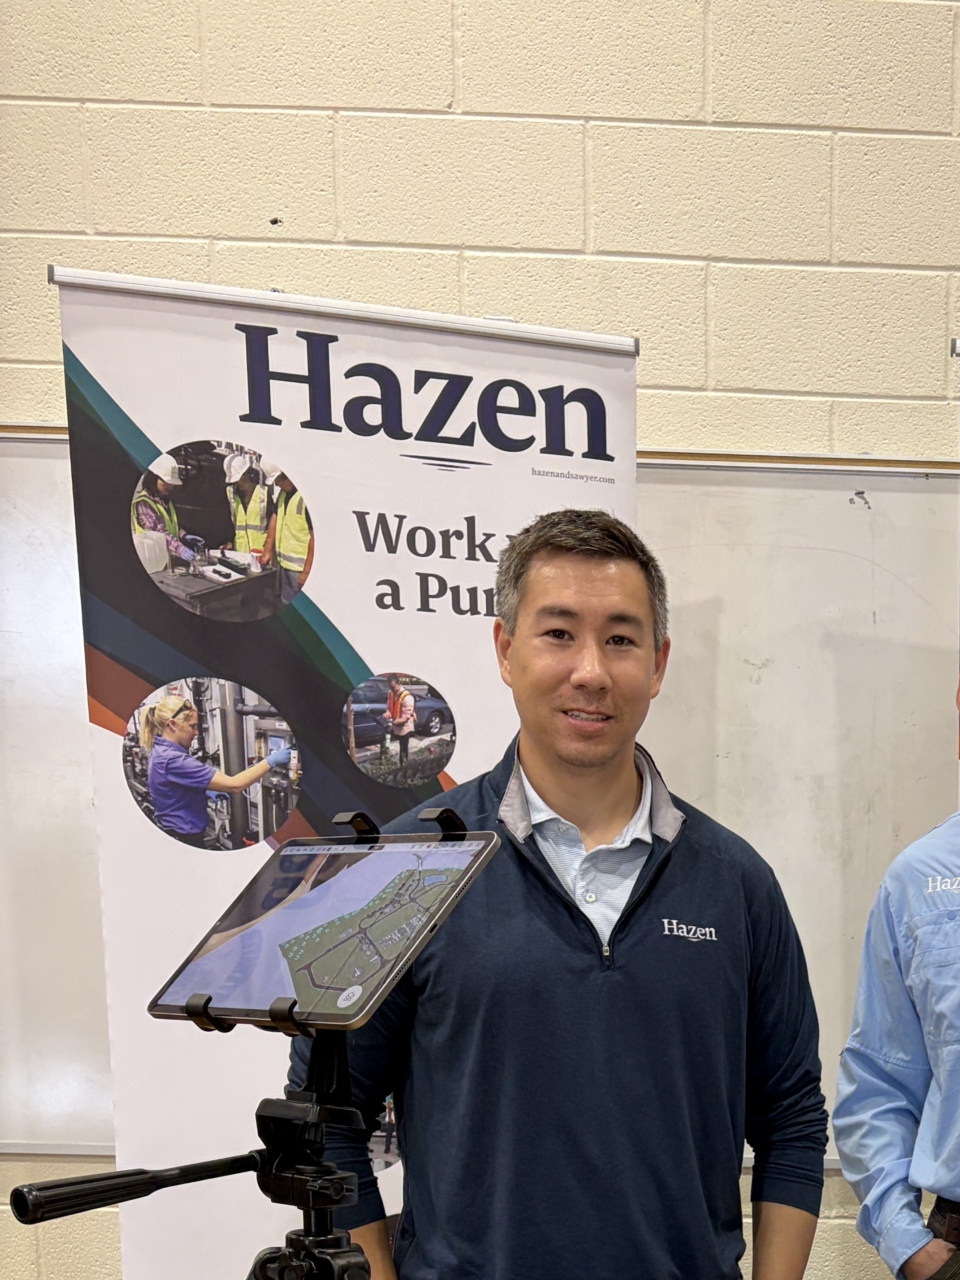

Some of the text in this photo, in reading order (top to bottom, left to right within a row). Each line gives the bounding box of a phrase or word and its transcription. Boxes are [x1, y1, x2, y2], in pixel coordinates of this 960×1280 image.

[235, 323, 615, 462] Hazen
[532, 468, 615, 484] hazenandsawyer.com
[352, 510, 498, 564] Work
[376, 571, 498, 618] a Pur
[662, 919, 717, 941] Hazen
